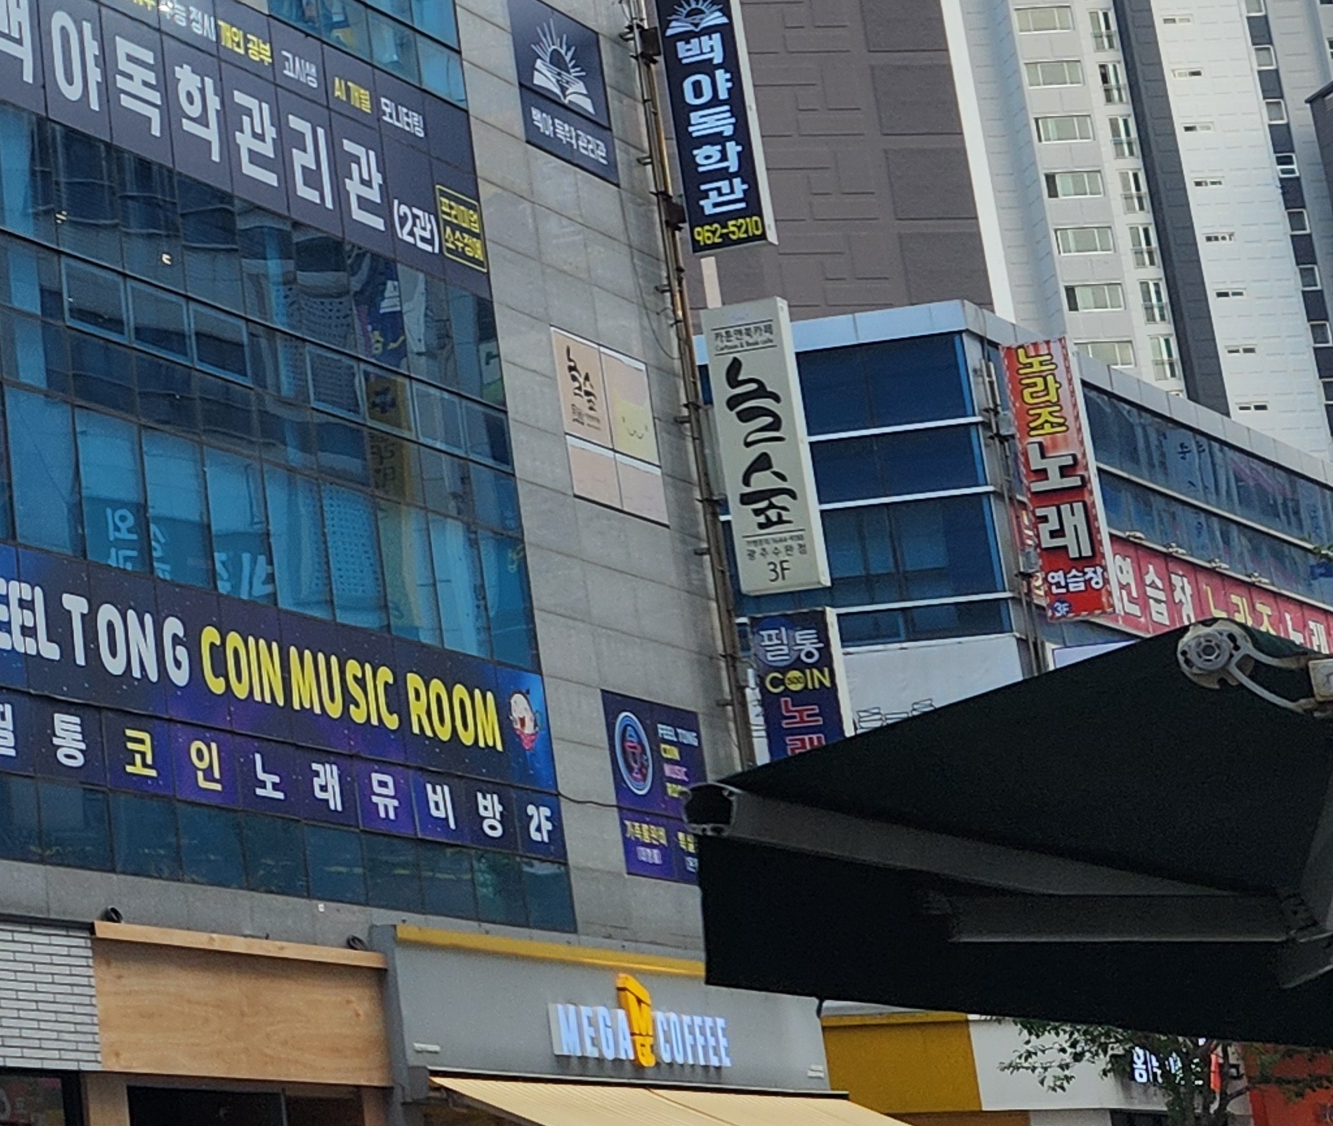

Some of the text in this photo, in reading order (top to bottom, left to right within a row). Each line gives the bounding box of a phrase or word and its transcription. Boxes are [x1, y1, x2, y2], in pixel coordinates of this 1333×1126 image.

[380, 96, 425, 138] 모니터링
[675, 32, 749, 216] 백야독학관
[393, 198, 440, 255] (2관)
[693, 215, 764, 247] 962-5210
[1015, 345, 1069, 437] 노라조
[1026, 440, 1094, 559] 노래
[767, 559, 791, 583] 3F
[1047, 565, 1104, 594] 연습장
[1053, 601, 1070, 617] 3F
[758, 626, 825, 664] 필통
[61, 591, 191, 687] TONG
[200, 625, 285, 708] COIN
[289, 645, 400, 731] MUSIC
[406, 672, 504, 752] ROOM
[765, 667, 832, 694] COIN
[526, 803, 554, 844] 2F
[549, 1003, 732, 1068] MEGA COFFEE
